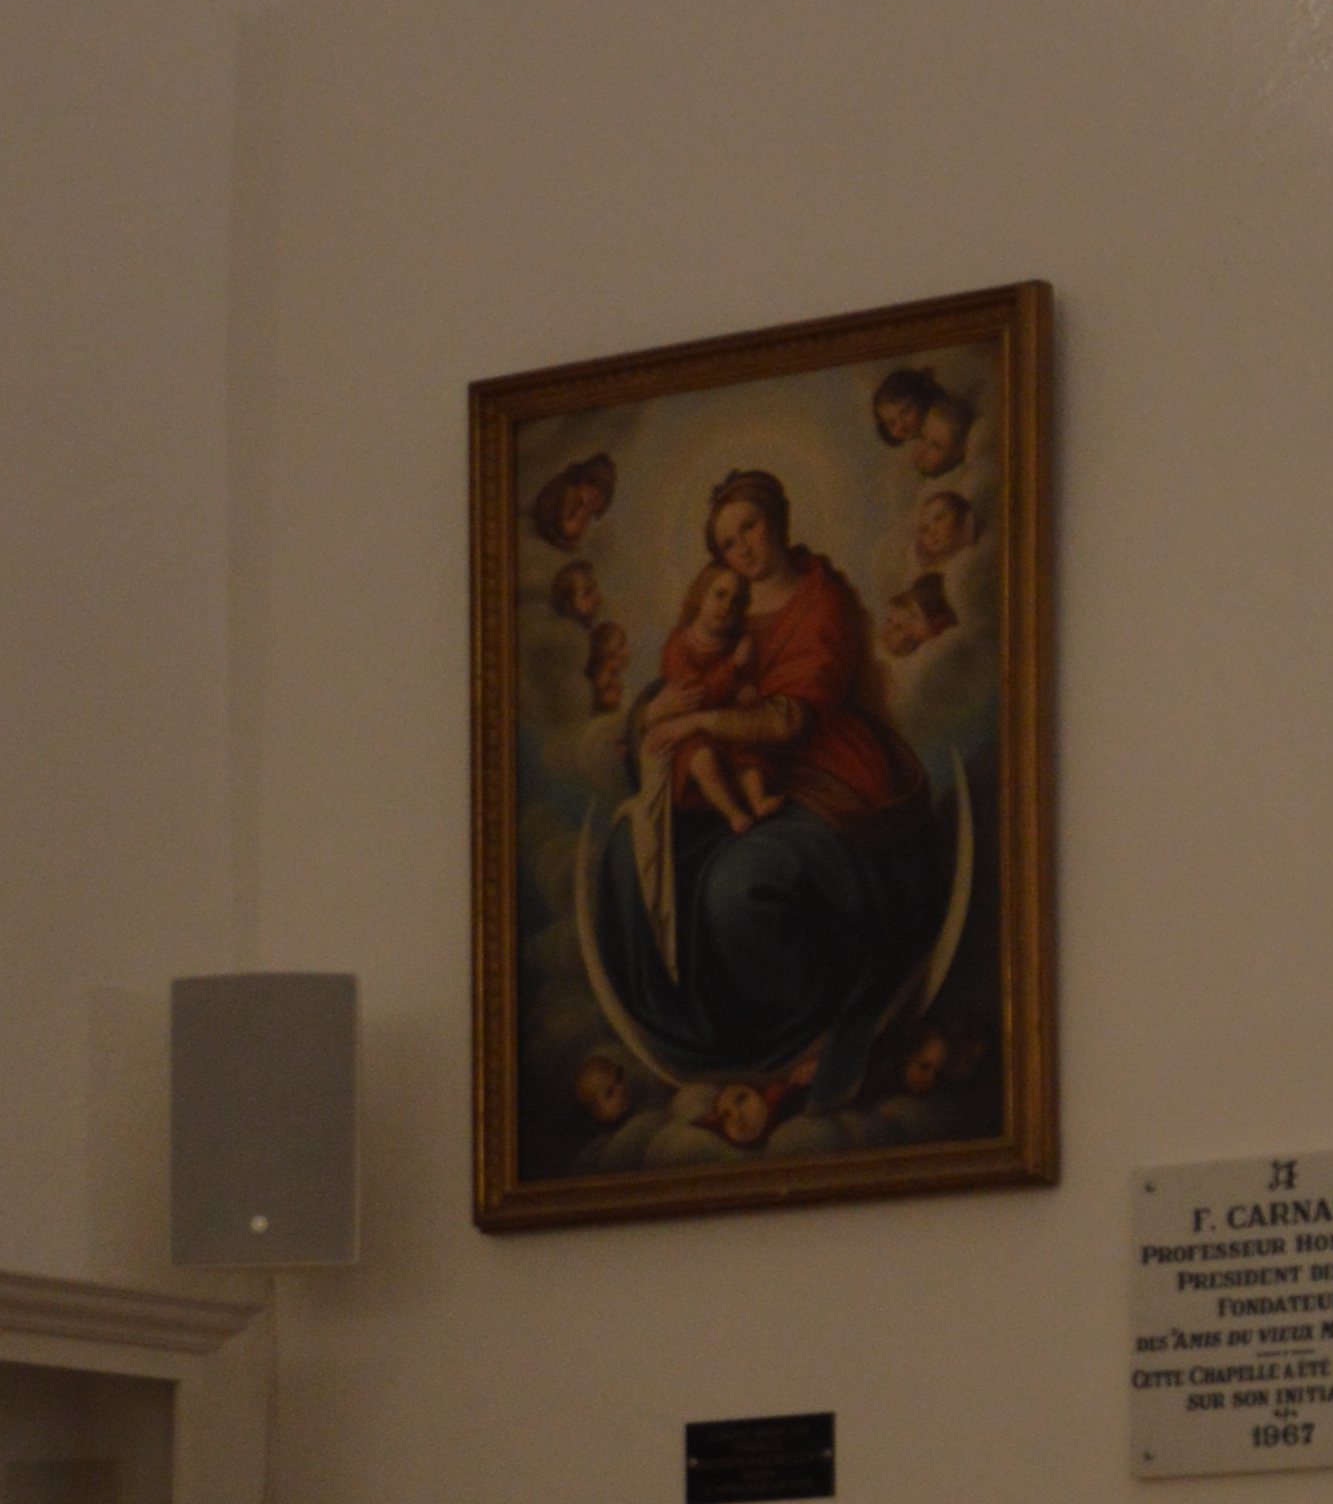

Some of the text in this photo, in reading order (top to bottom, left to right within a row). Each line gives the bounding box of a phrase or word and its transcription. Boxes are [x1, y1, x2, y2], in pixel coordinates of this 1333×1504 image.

[1193, 1208, 1216, 1233] F.
[1141, 1237, 1286, 1266] PROFESSEUR
[1136, 1335, 1168, 1352] DES
[1227, 1330, 1252, 1346] DU
[1258, 1324, 1315, 1343] VIEUX
[1132, 1369, 1184, 1389] CETTE
[1189, 1362, 1279, 1385] CHAPELLE
[1186, 1390, 1225, 1412] SUR
[1232, 1387, 1270, 1408] SON
[1251, 1422, 1316, 1448] 1967
